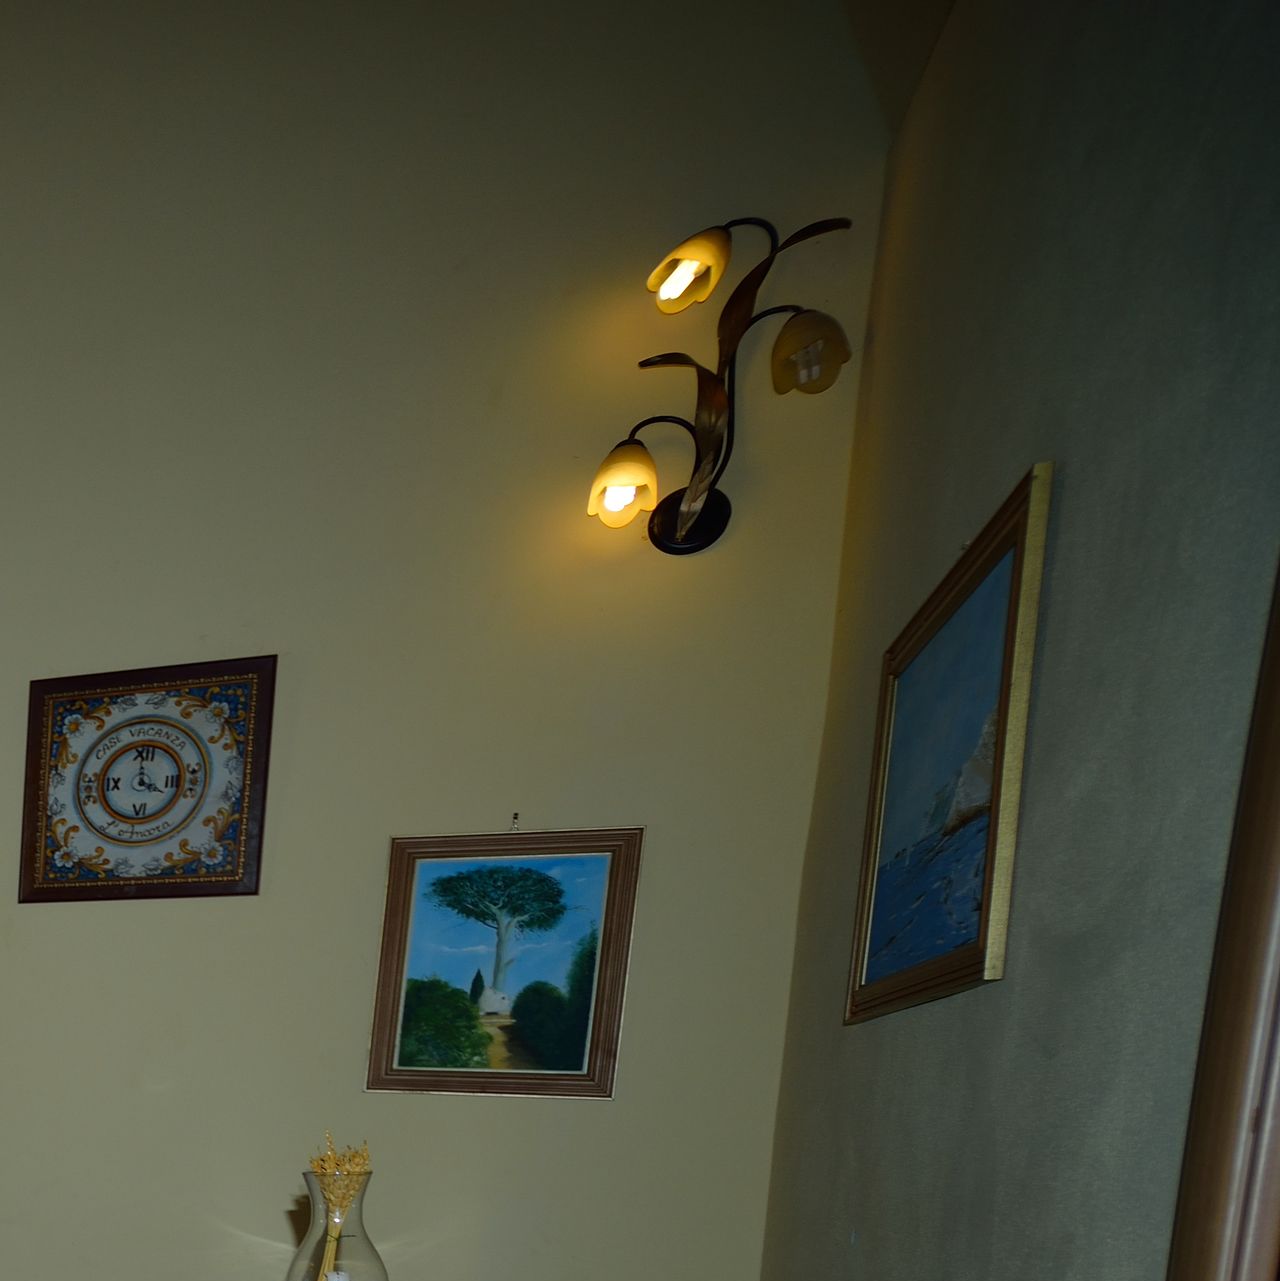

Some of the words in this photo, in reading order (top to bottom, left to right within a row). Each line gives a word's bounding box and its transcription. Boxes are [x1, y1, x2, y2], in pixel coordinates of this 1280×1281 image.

[128, 728, 186, 751] VACANZA
[133, 746, 155, 761] XII
[106, 777, 121, 791] IX
[165, 774, 180, 788] III
[132, 803, 147, 816] VI
